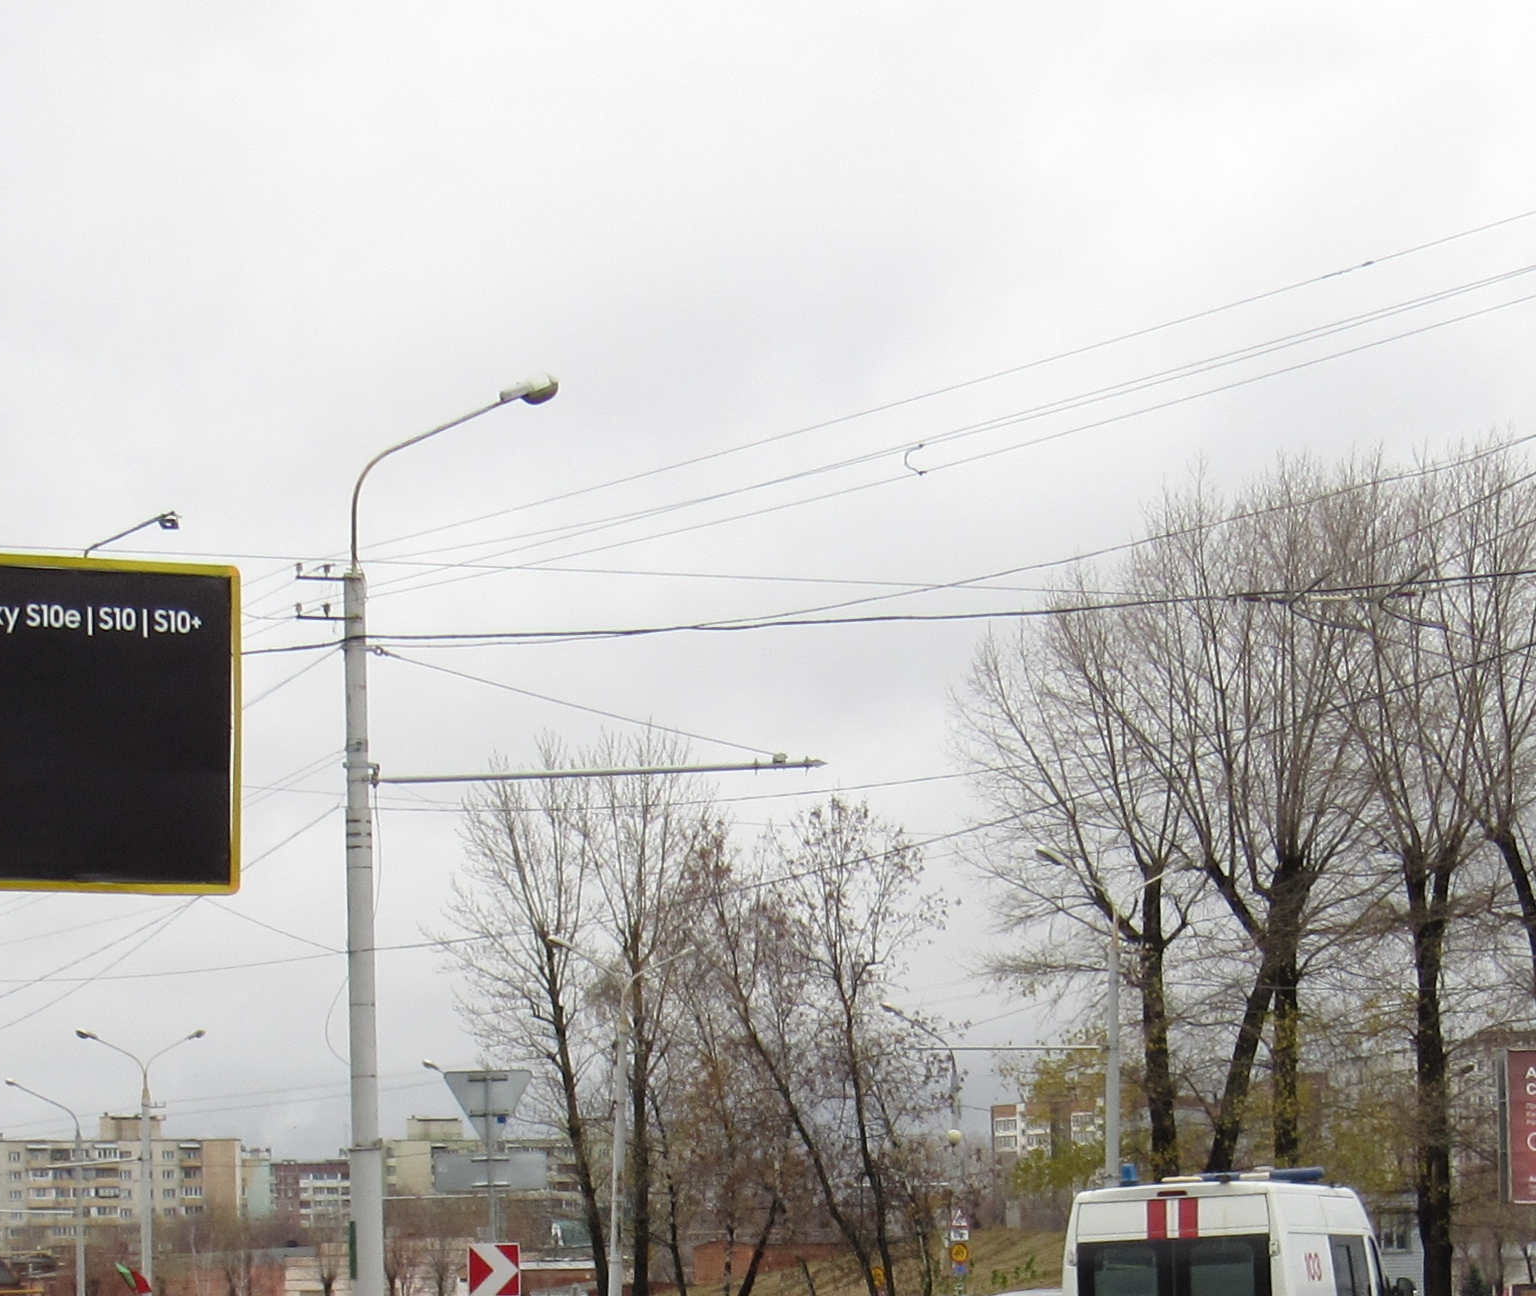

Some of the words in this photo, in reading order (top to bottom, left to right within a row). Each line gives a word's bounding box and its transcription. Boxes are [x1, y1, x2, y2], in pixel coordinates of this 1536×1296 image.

[25, 603, 82, 629] S10e
[98, 607, 136, 631] S10
[154, 610, 202, 633] S10+
[1305, 1253, 1322, 1281] 103
